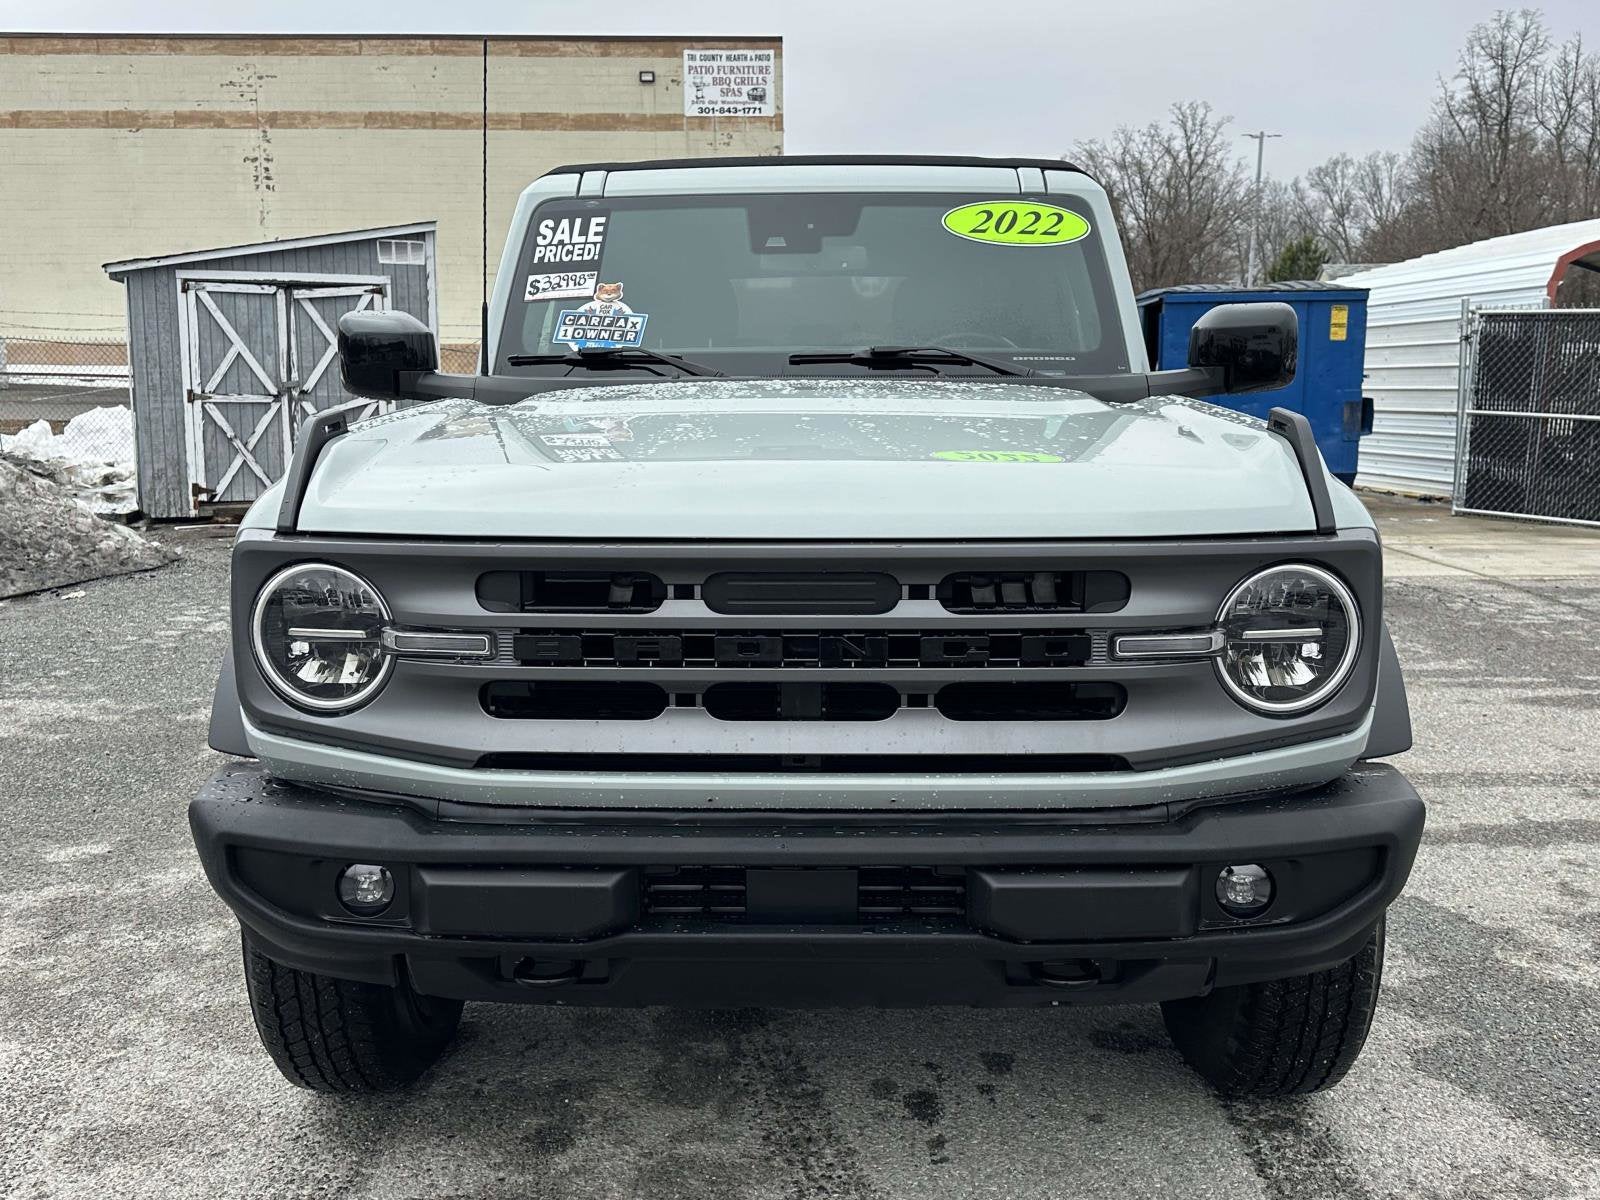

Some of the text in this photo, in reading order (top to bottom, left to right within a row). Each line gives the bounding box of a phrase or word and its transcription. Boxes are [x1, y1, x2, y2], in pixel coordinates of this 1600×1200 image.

[687, 54, 697, 62] TRI
[699, 54, 723, 62] COUNTY
[726, 54, 748, 62] HEARTH
[755, 54, 771, 62] PATIO
[688, 65, 771, 75] PATIO FURNITURE
[712, 76, 768, 87] BBQ GRILLS
[720, 87, 743, 97] SPAS
[968, 209, 1064, 236] 2022
[536, 216, 607, 246] SALE
[533, 243, 601, 263] PRICED!
[565, 316, 639, 330] CARFAX
[562, 329, 637, 341] 1 OWNER
